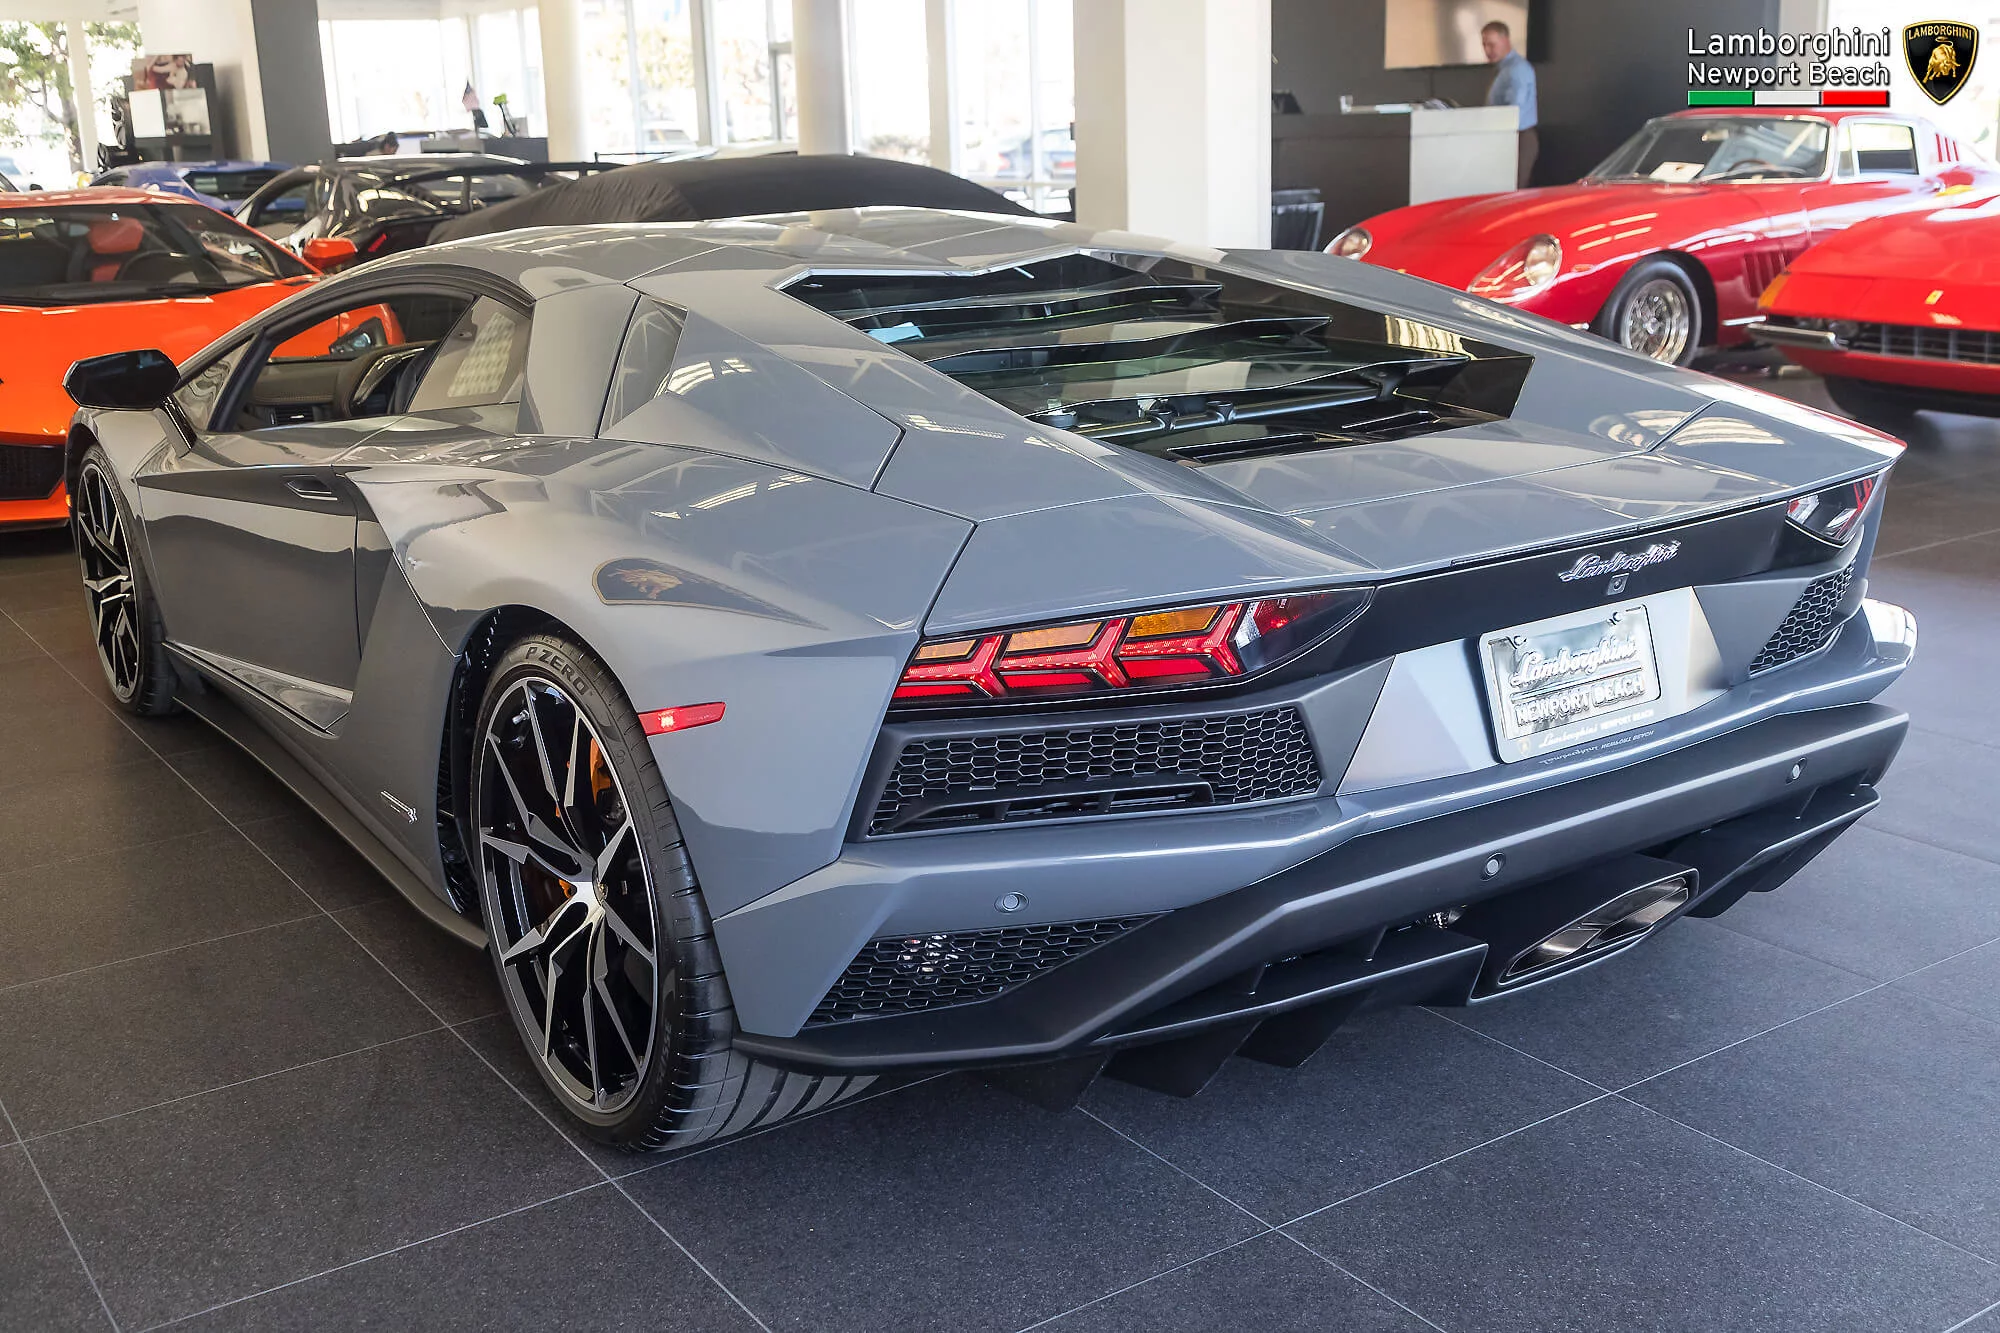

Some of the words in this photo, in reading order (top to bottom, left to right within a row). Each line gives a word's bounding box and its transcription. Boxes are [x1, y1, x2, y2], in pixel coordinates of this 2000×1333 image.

[1558, 541, 1681, 582] Lamborghini
[525, 646, 538, 660] P
[538, 650, 591, 696] ZERO
[1510, 637, 1639, 688] Lamborghini
[1515, 688, 1592, 727] NEWPORT
[1592, 676, 1646, 708] BEACH
